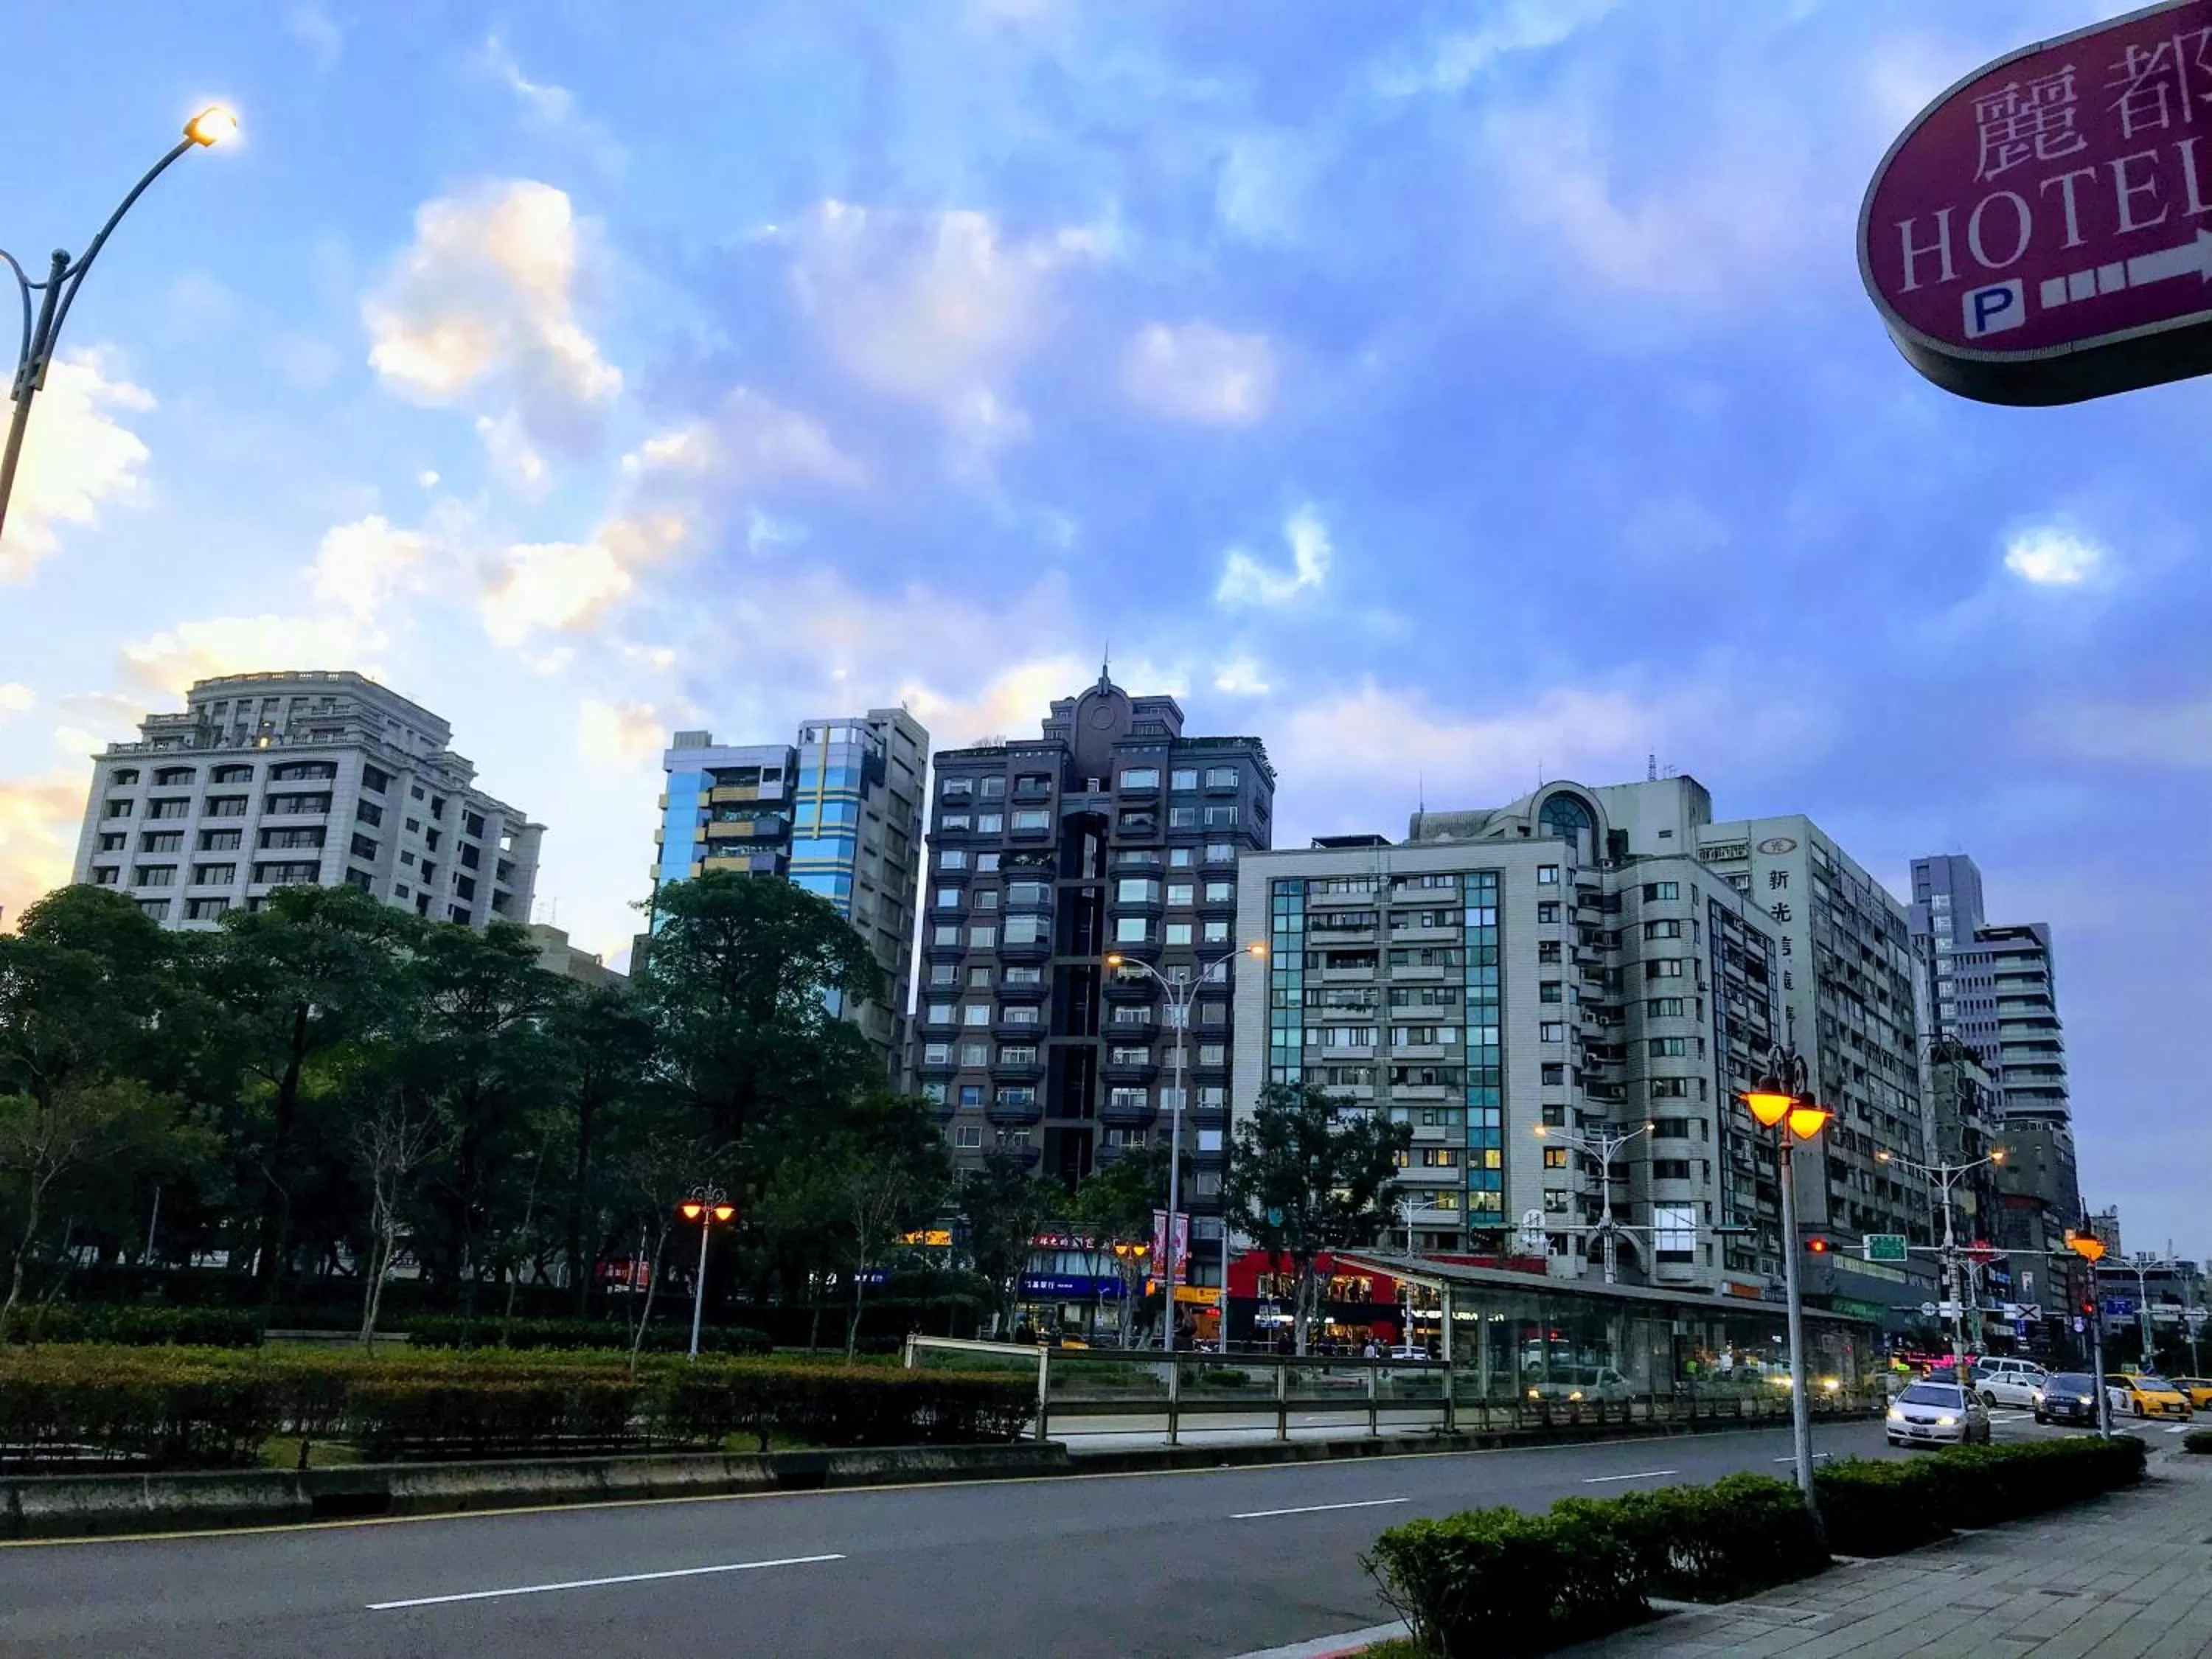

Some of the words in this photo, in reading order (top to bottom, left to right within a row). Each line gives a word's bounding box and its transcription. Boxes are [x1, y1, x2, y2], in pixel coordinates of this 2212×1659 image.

[1971, 27, 2212, 184] 麗都
[1894, 136, 2212, 293] HOTEL
[1975, 288, 2013, 332] P
[1452, 1312, 1505, 1322] ARMR
